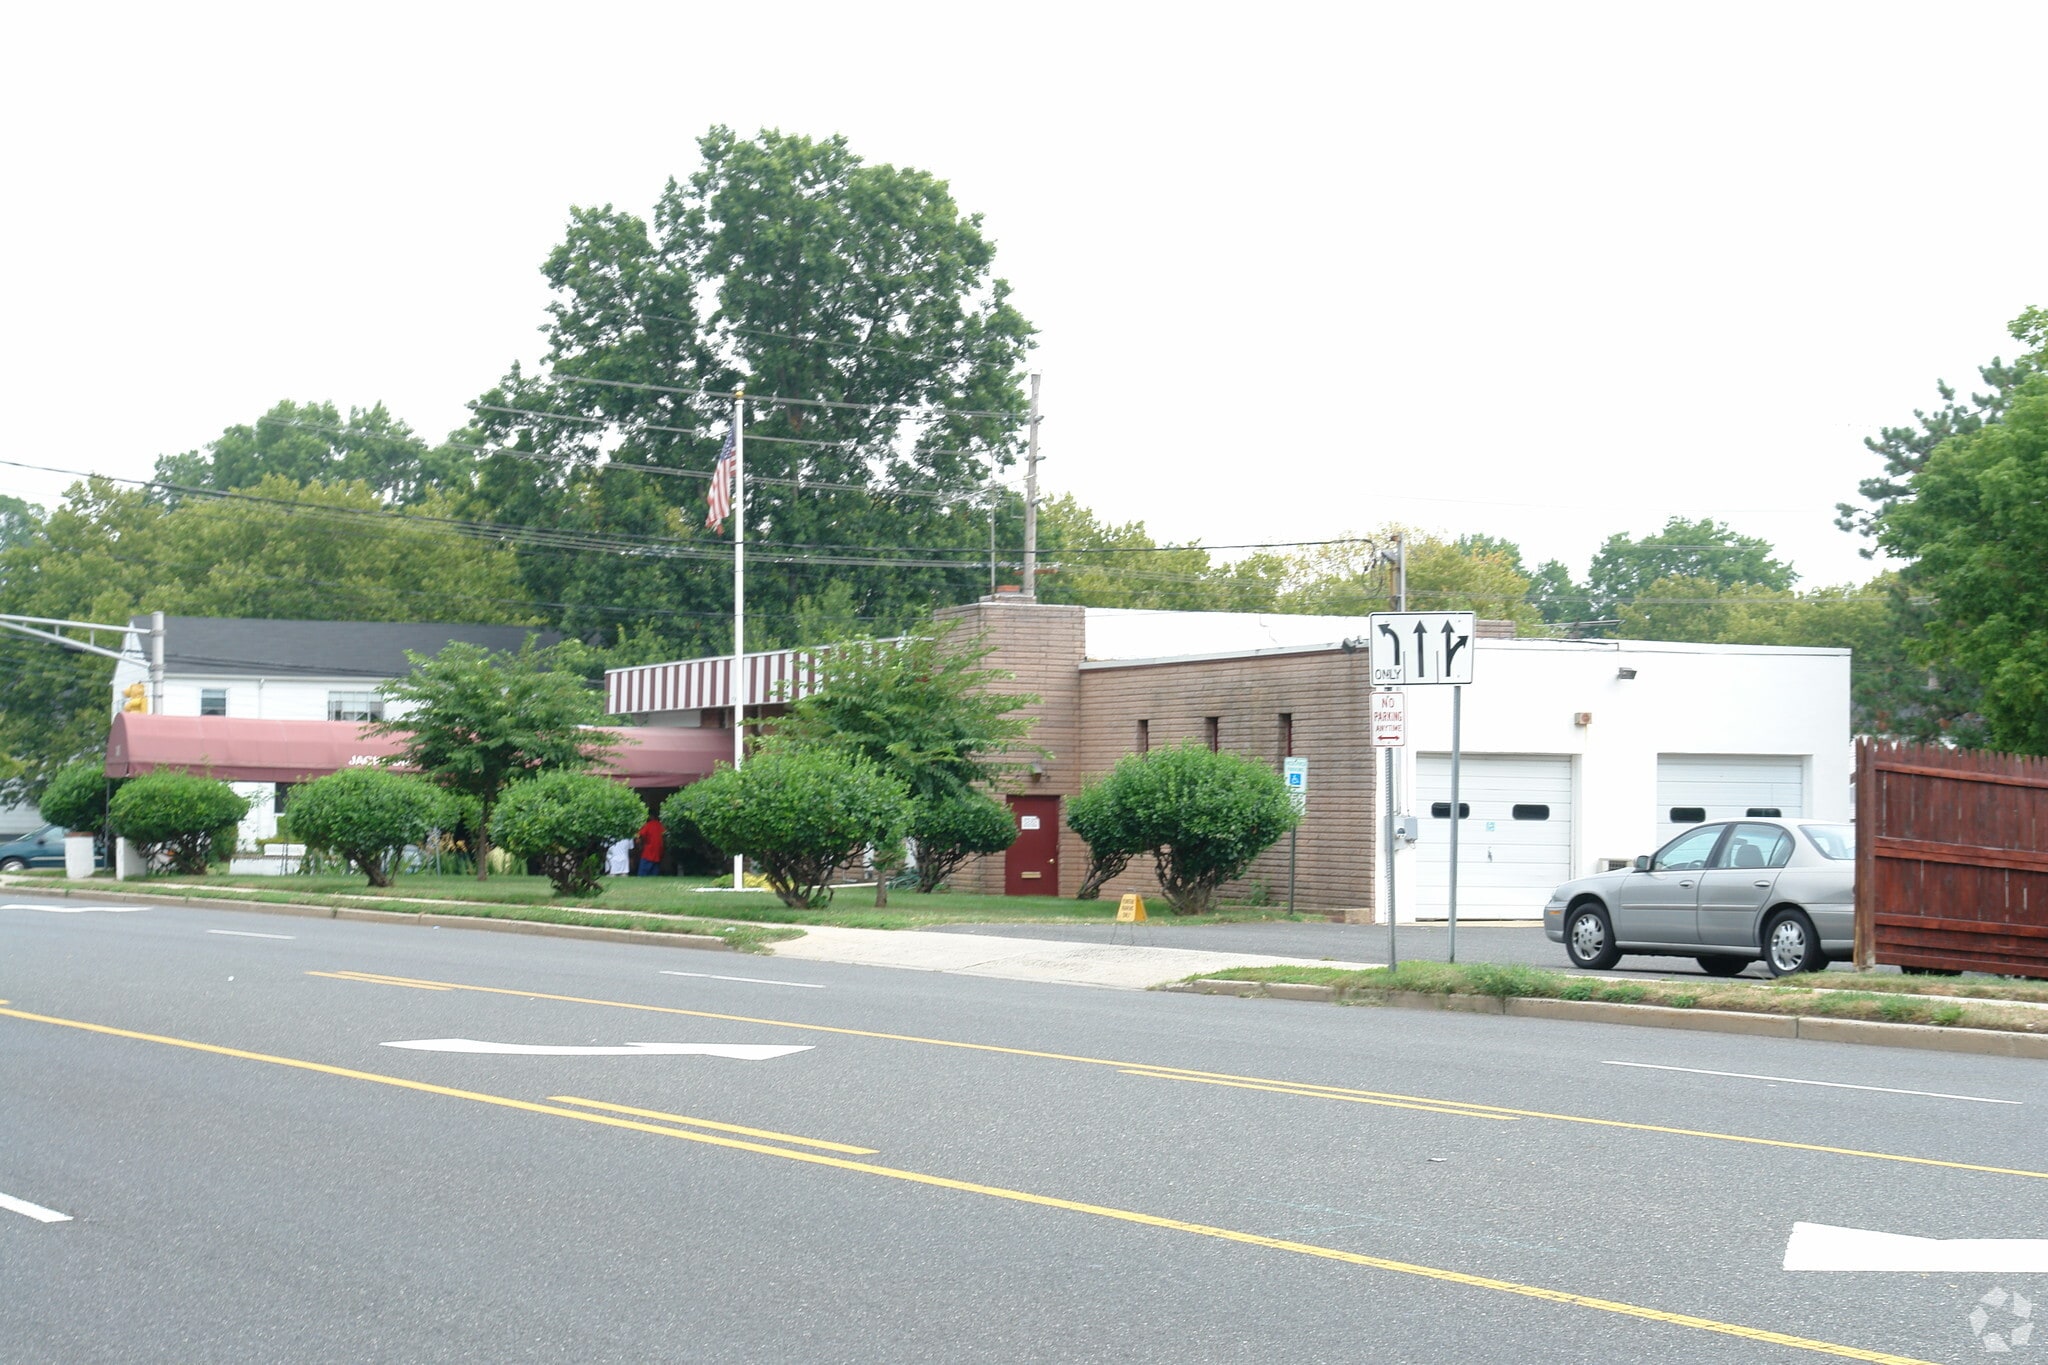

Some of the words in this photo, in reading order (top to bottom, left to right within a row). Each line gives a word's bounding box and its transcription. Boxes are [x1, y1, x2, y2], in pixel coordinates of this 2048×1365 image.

[1375, 669, 1401, 679] ONLY
[1382, 698, 1394, 708] NO
[1374, 712, 1402, 721] PARKING
[1375, 724, 1402, 732] ANYTIME
